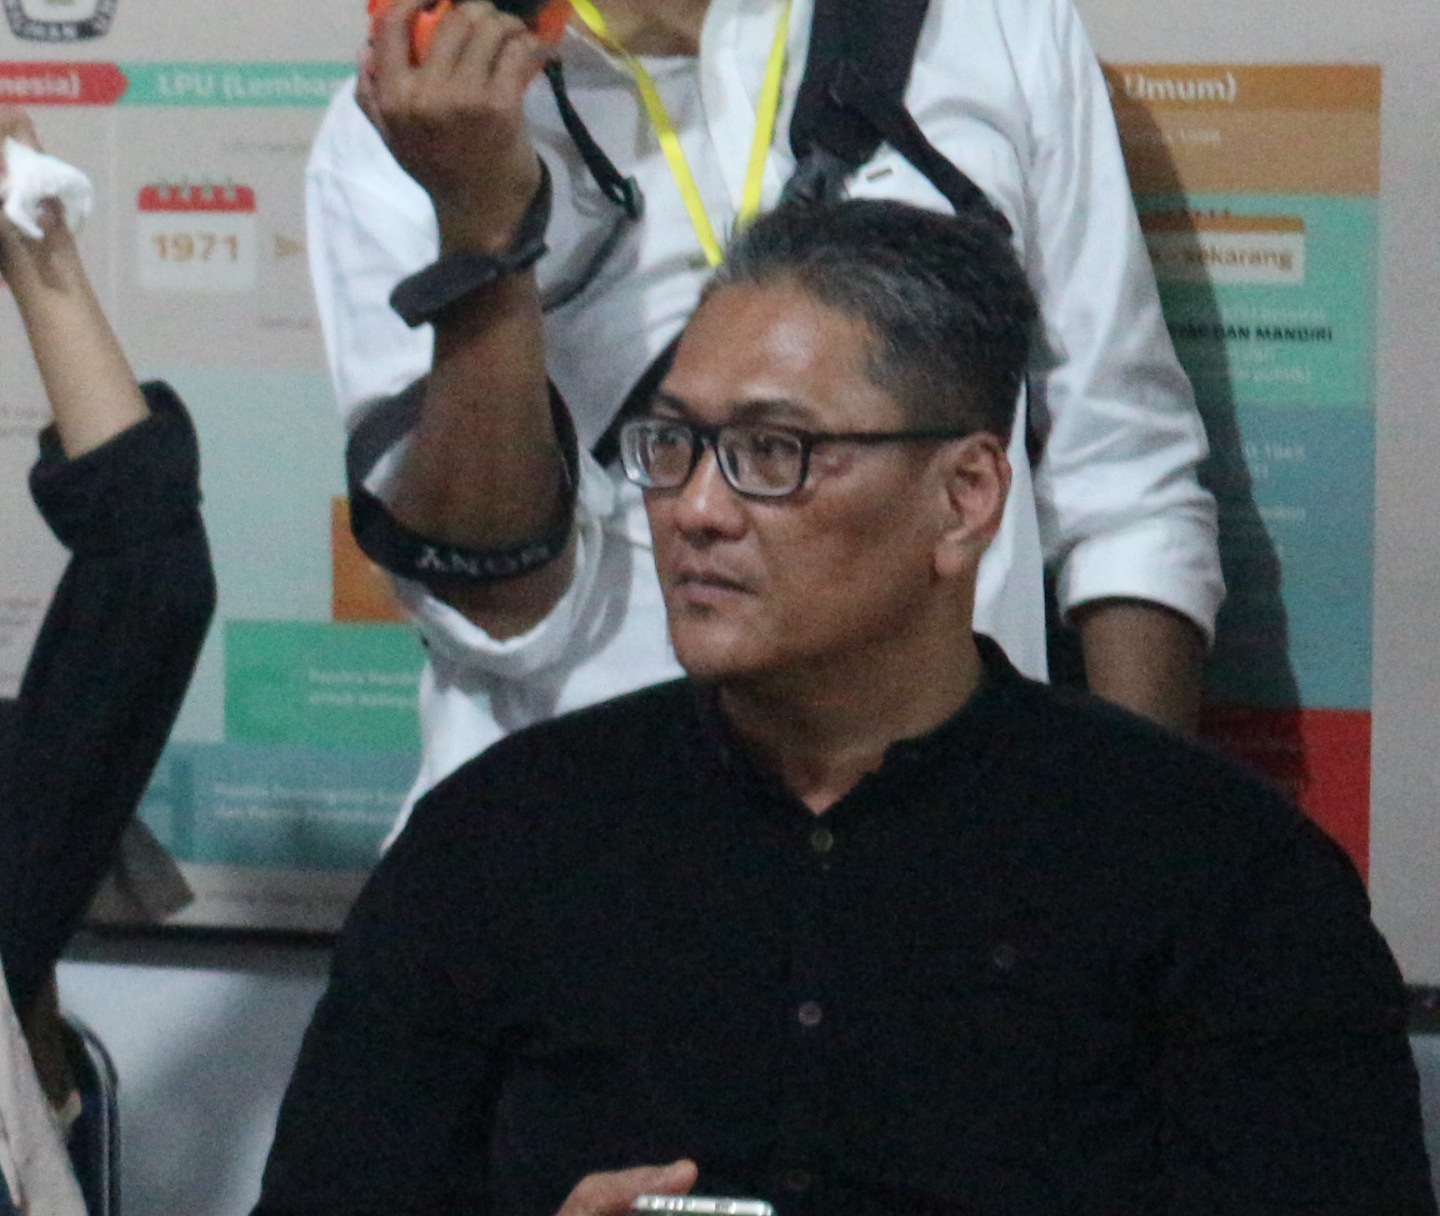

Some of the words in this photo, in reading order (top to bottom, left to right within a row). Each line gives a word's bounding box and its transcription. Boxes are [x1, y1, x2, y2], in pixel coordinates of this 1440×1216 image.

[157, 73, 214, 96] LPU
[1123, 71, 1237, 103] Umum)
[153, 233, 239, 262] 1971
[1254, 326, 1333, 341] MANDIRI
